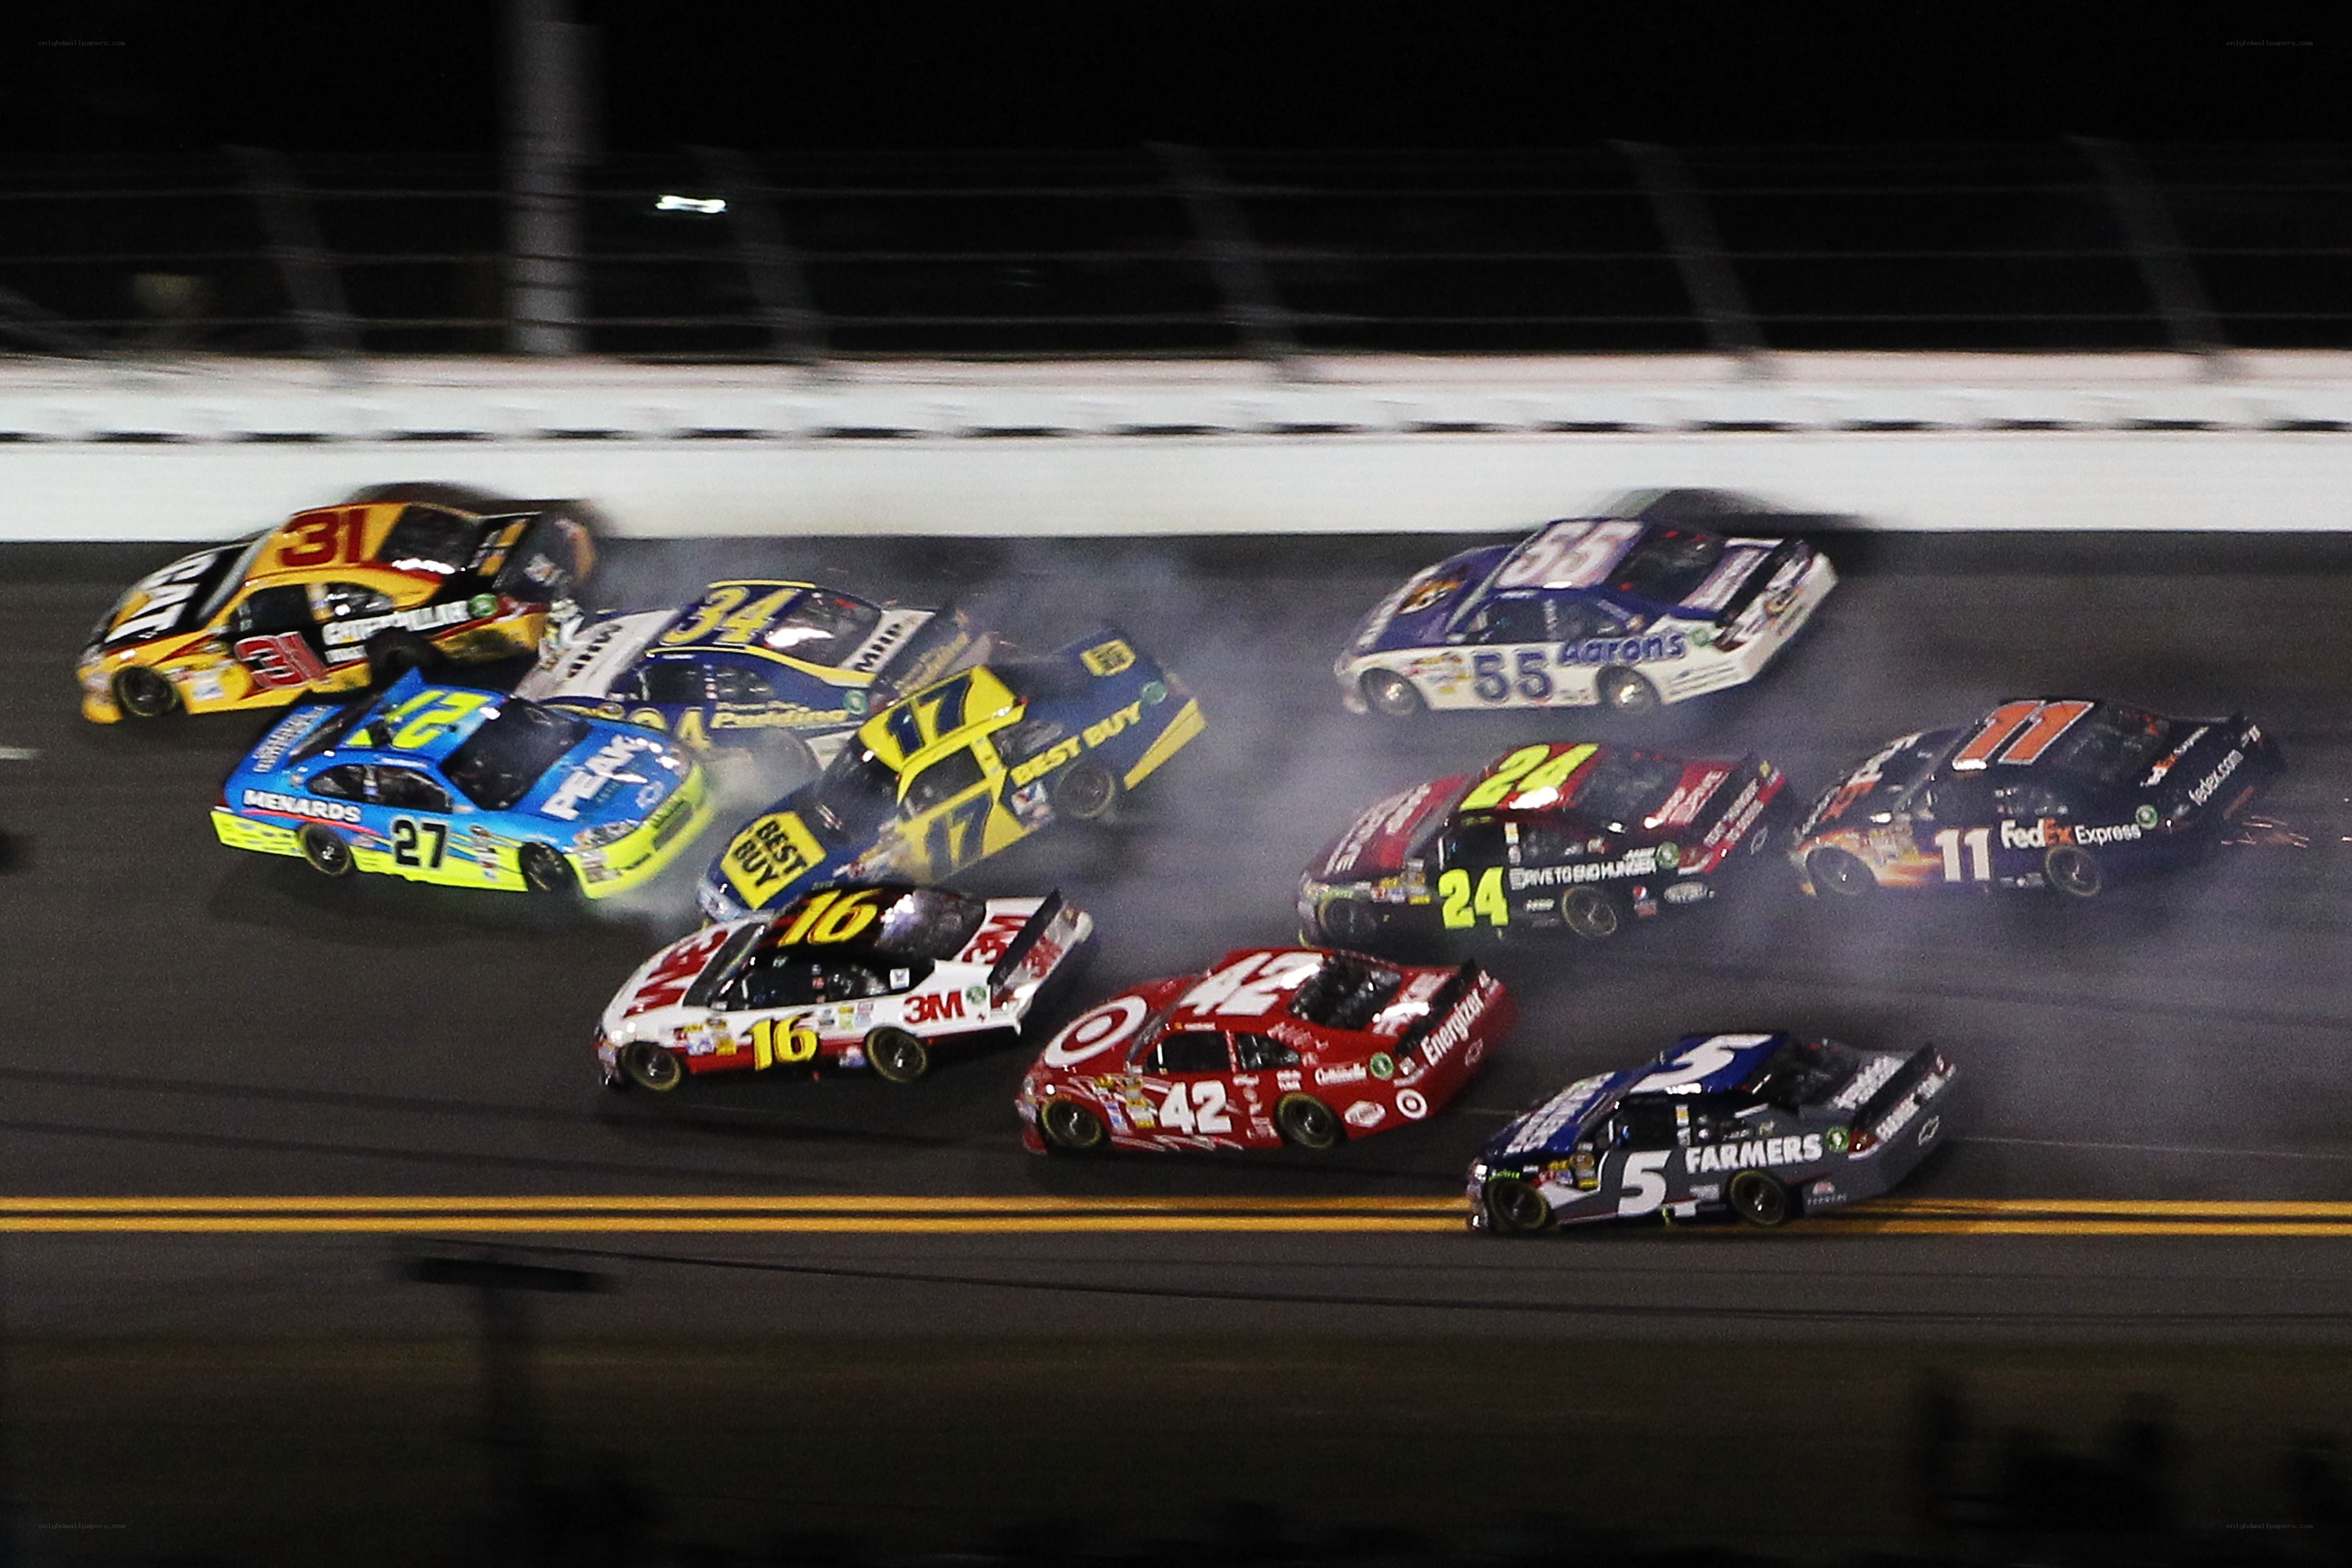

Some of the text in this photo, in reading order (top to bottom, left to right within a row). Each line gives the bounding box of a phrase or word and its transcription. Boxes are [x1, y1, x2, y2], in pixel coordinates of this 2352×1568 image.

[279, 509, 369, 567] 31
[1494, 520, 1645, 590] 55
[659, 587, 801, 646] 34
[234, 630, 332, 689] 31
[1473, 649, 1554, 704] 55
[885, 674, 973, 756] 17
[1010, 699, 1142, 788] BEST BUY
[1952, 700, 2095, 765] 11
[243, 789, 362, 822] MENARDS
[1458, 743, 1601, 812] 24
[2188, 748, 2244, 807] fedex.com
[390, 815, 449, 870] 27
[755, 820, 807, 874] BEST
[1934, 827, 1993, 883] 11
[2001, 817, 2142, 850] FedEx Express
[734, 840, 779, 888] BUY
[776, 888, 883, 946] 16
[1438, 866, 1510, 929] 24
[903, 991, 967, 1025] 3M
[1178, 951, 1326, 1017] 42
[745, 1013, 820, 1071] 16
[1420, 989, 1485, 1066] Energizer
[1629, 1034, 1773, 1093] 5
[1159, 1080, 1233, 1135] 42
[1685, 1134, 1823, 1174] FARMERS
[1617, 1150, 1672, 1217] 5
